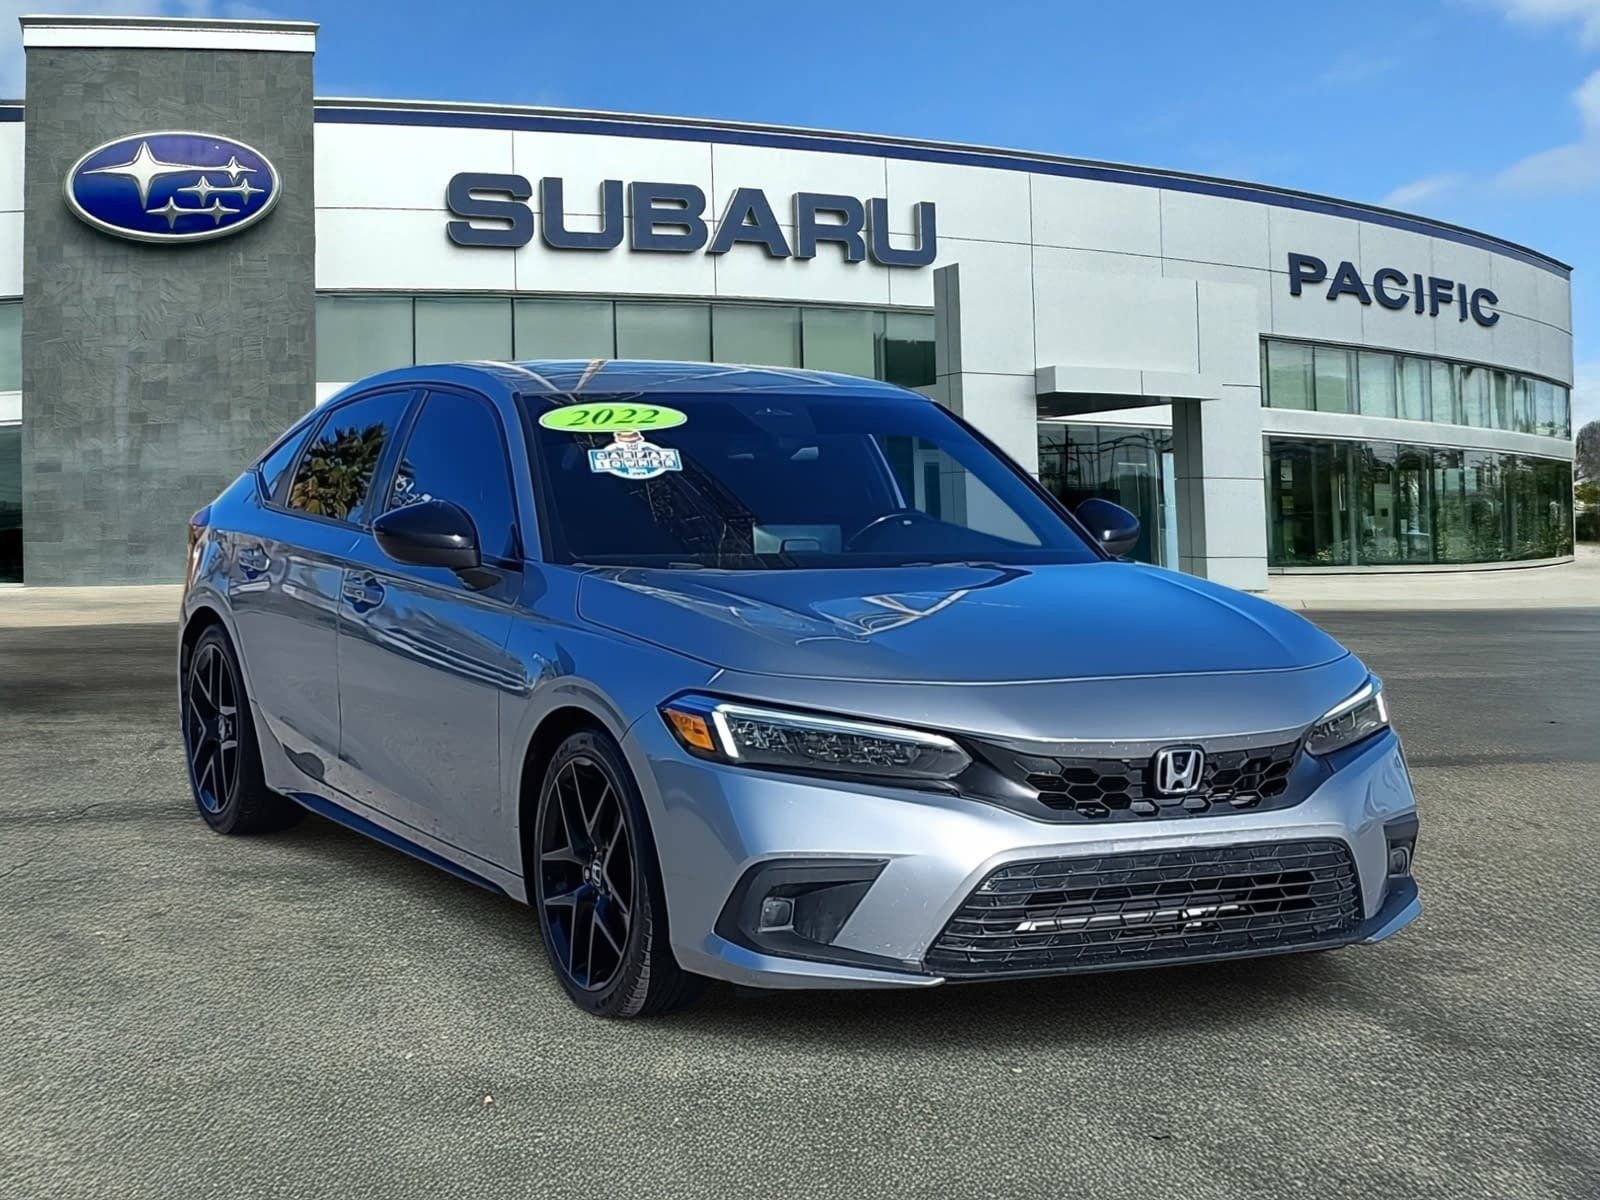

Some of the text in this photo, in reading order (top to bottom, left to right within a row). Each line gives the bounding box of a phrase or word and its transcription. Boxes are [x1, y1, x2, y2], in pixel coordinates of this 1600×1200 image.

[447, 172, 937, 267] SUBARU
[1287, 252, 1500, 327] PACIFIC
[567, 408, 660, 426] 2022
